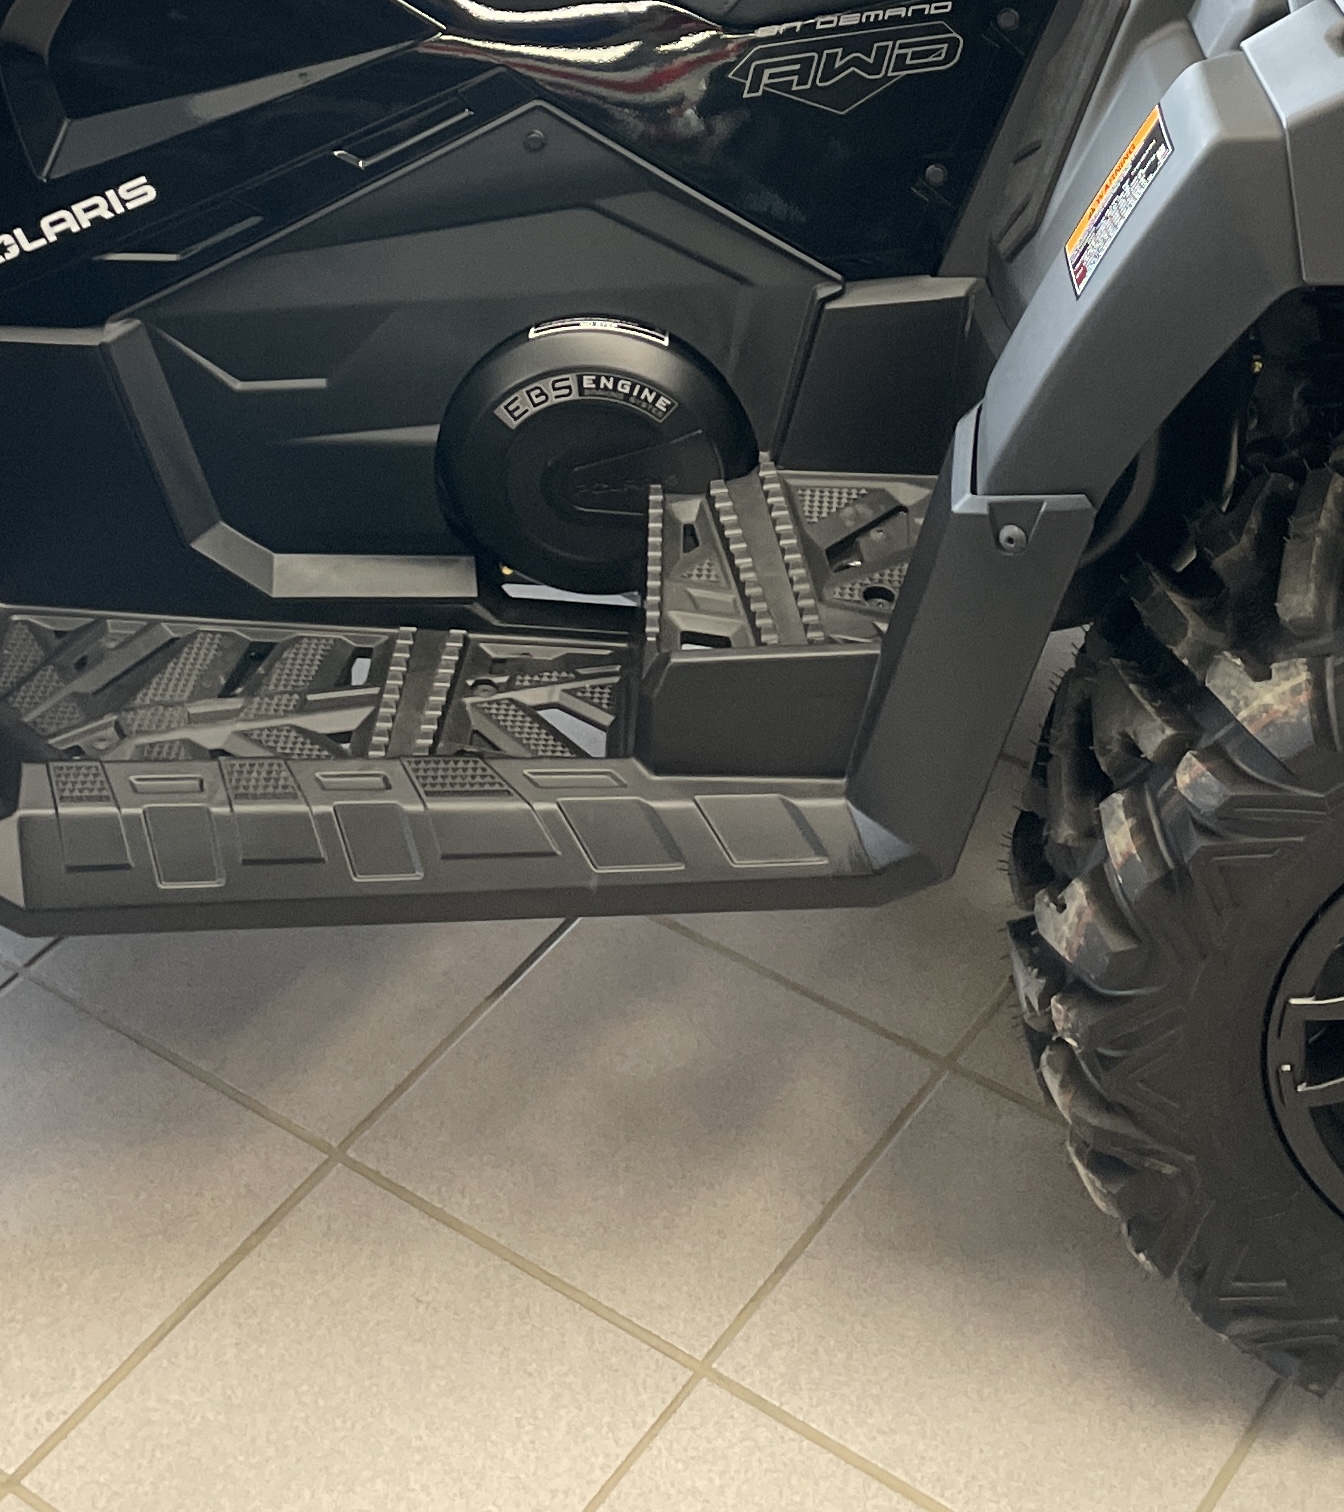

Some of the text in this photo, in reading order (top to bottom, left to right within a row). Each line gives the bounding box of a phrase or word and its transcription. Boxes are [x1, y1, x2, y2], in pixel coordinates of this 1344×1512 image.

[743, 32, 964, 99] AWD
[504, 374, 672, 422] EBS ENGINE
